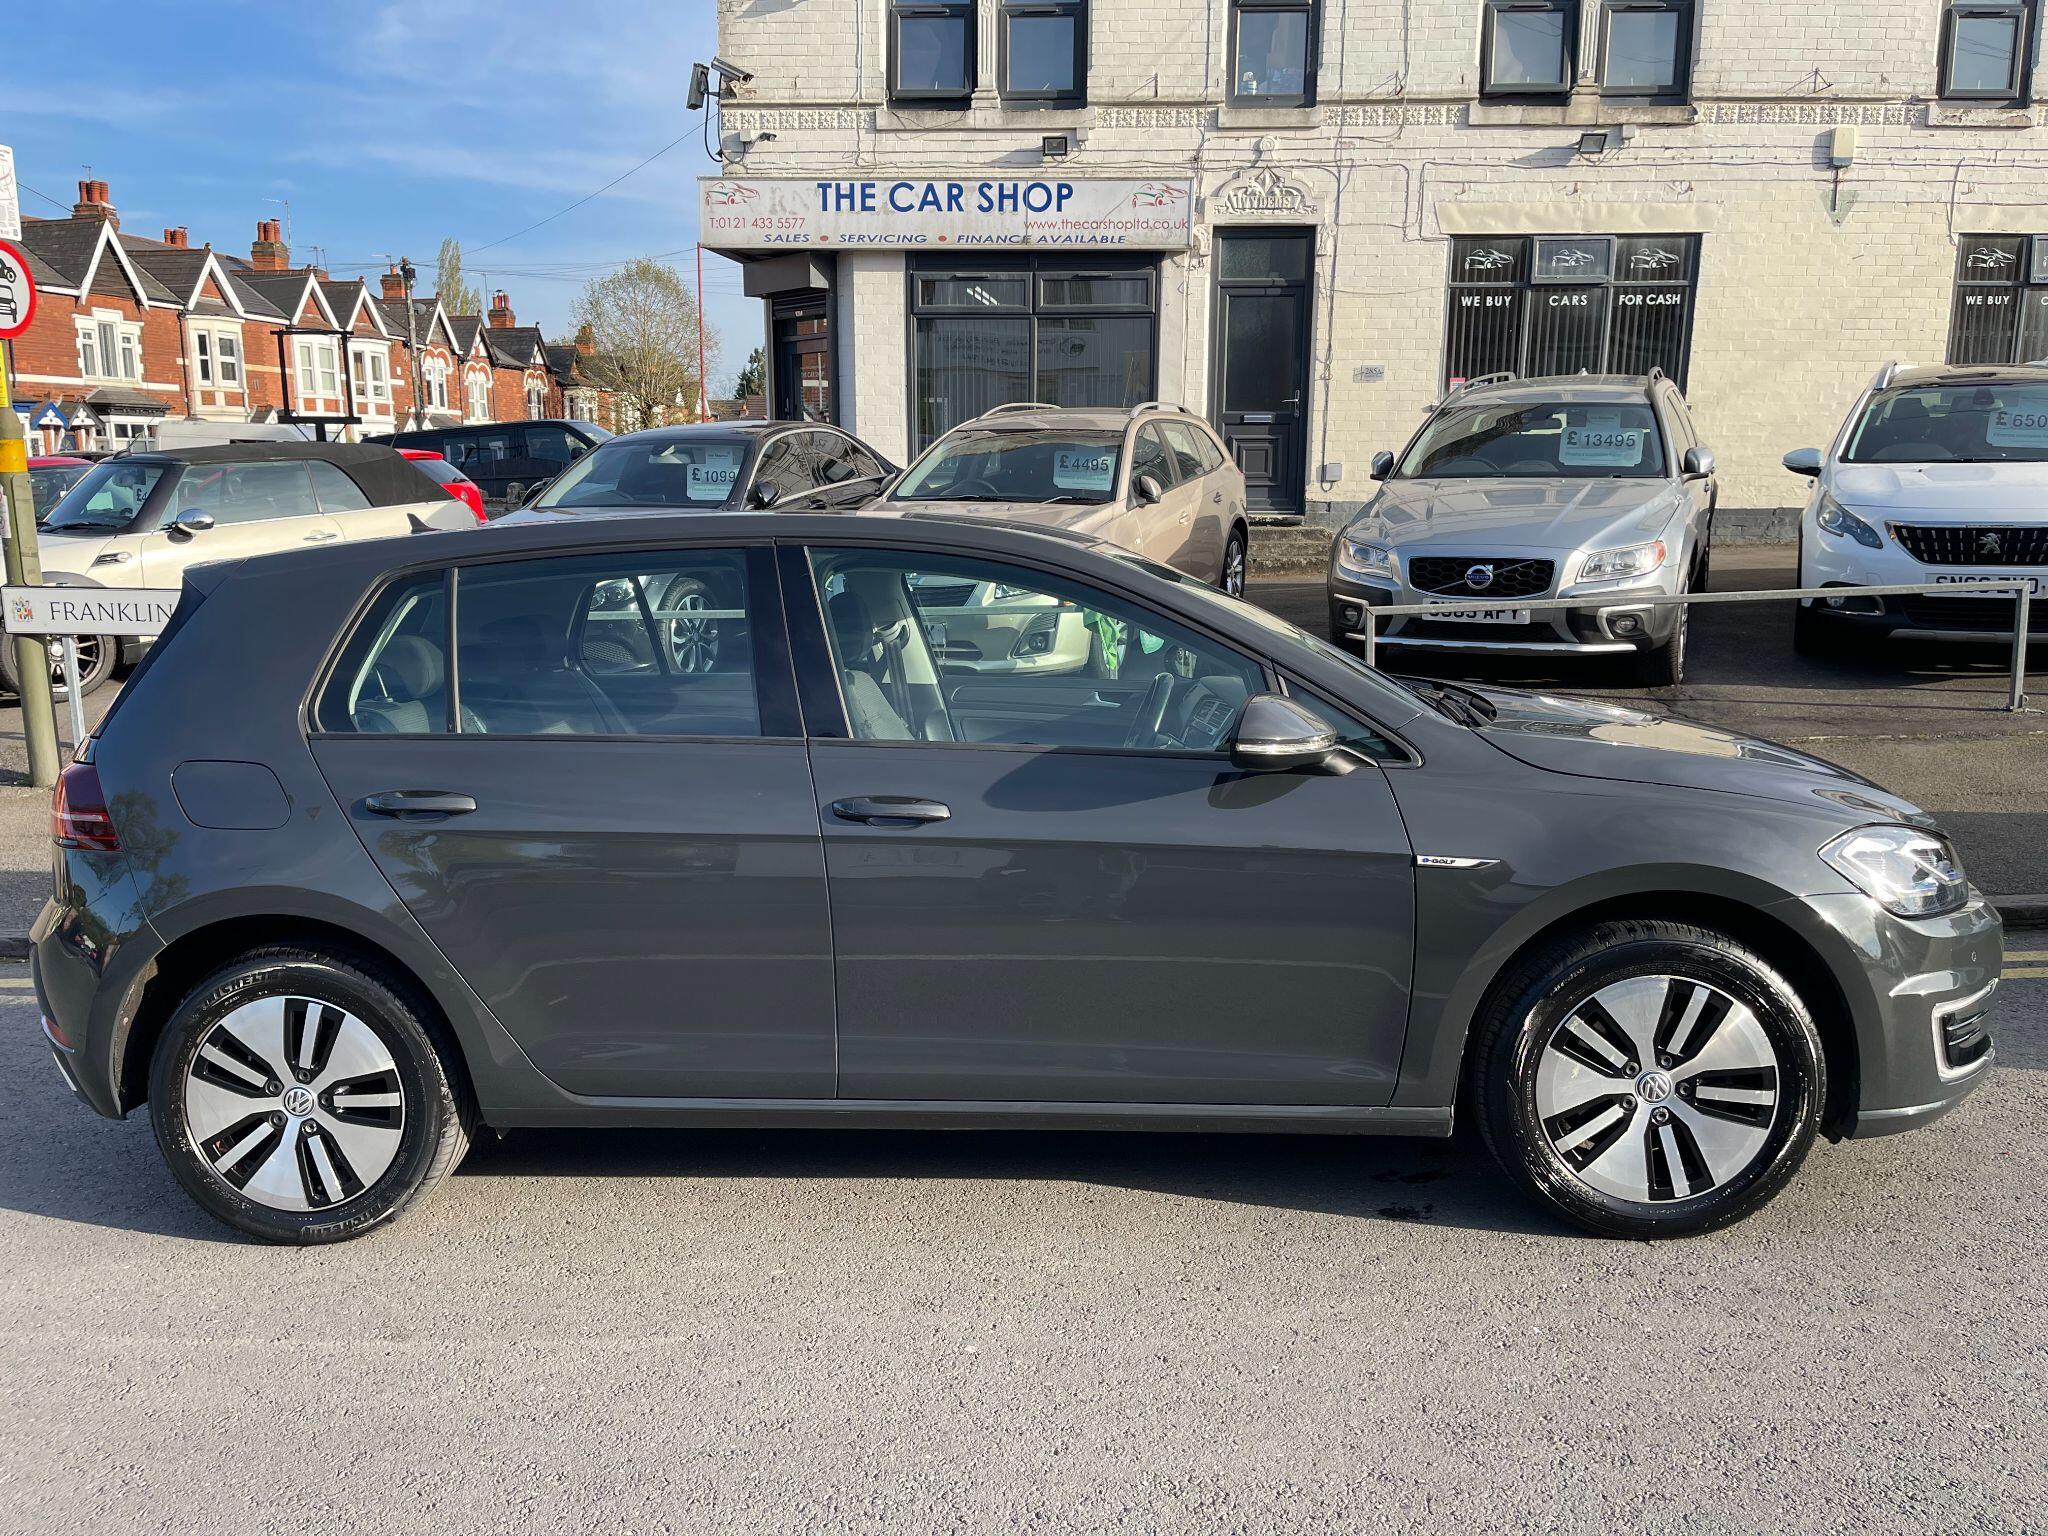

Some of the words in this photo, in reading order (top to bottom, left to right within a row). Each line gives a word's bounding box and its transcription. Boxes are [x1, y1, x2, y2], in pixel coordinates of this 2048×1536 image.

[816, 182, 876, 212] THE
[888, 181, 964, 212] CAR
[976, 181, 1074, 213] SHOP
[751, 217, 773, 229] 433
[777, 217, 806, 229] 5577
[1024, 217, 1190, 232] www.thecarshopltd.co.uk
[763, 233, 810, 243] SALES
[838, 233, 928, 243] SERVICING
[956, 234, 1032, 244] FINANCE
[1036, 234, 1127, 244] AVAILABLE
[1461, 296, 1481, 307] WE
[1486, 295, 1512, 307] BUY
[1549, 295, 1588, 306] CARS
[1618, 294, 1643, 306] FOR
[1646, 293, 1681, 305] CASH
[1965, 295, 1982, 305] WE
[1987, 295, 2010, 305] BUY
[50, 601, 173, 623] FRANKLIN
